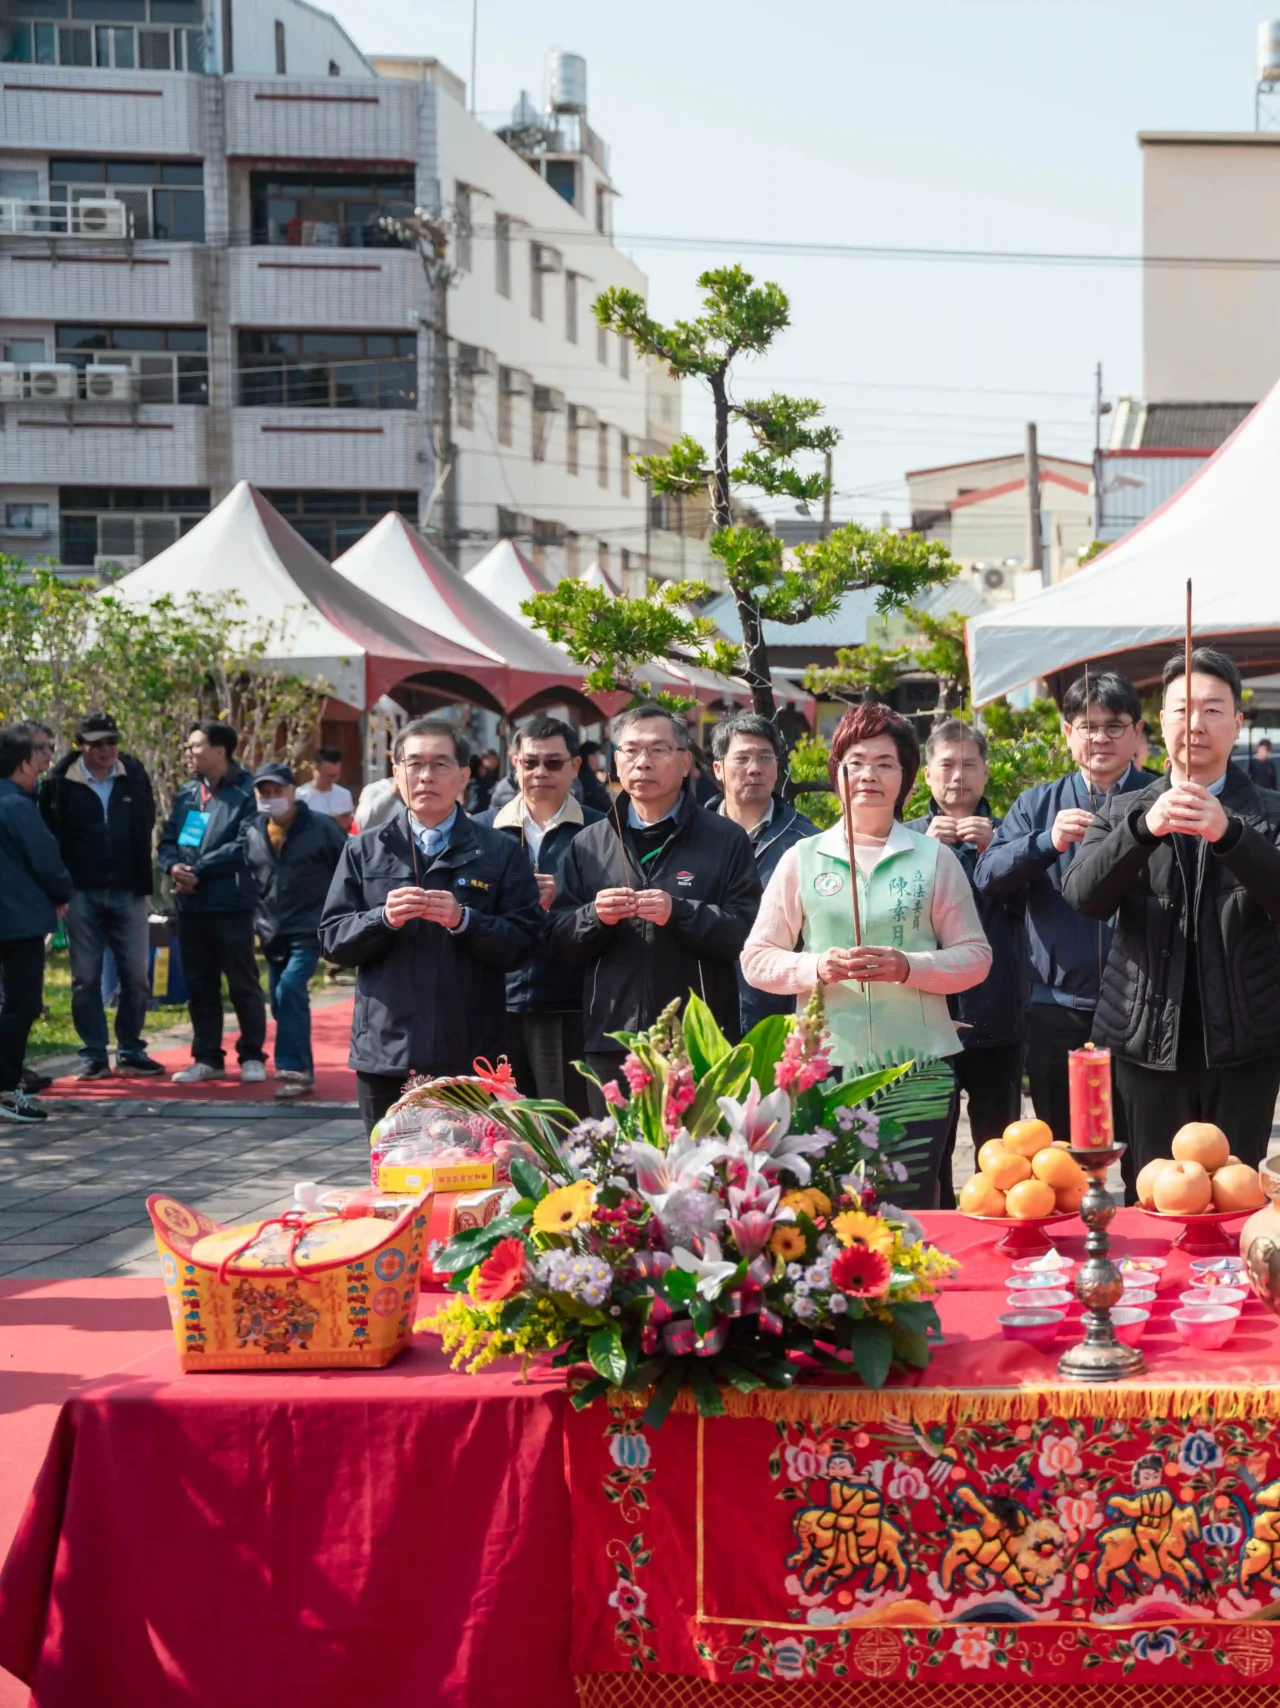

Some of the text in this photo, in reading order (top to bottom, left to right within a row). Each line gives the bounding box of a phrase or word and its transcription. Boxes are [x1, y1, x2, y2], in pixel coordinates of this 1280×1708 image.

[889, 876, 911, 946] 陳素月
[912, 870, 925, 930] 立法委員
